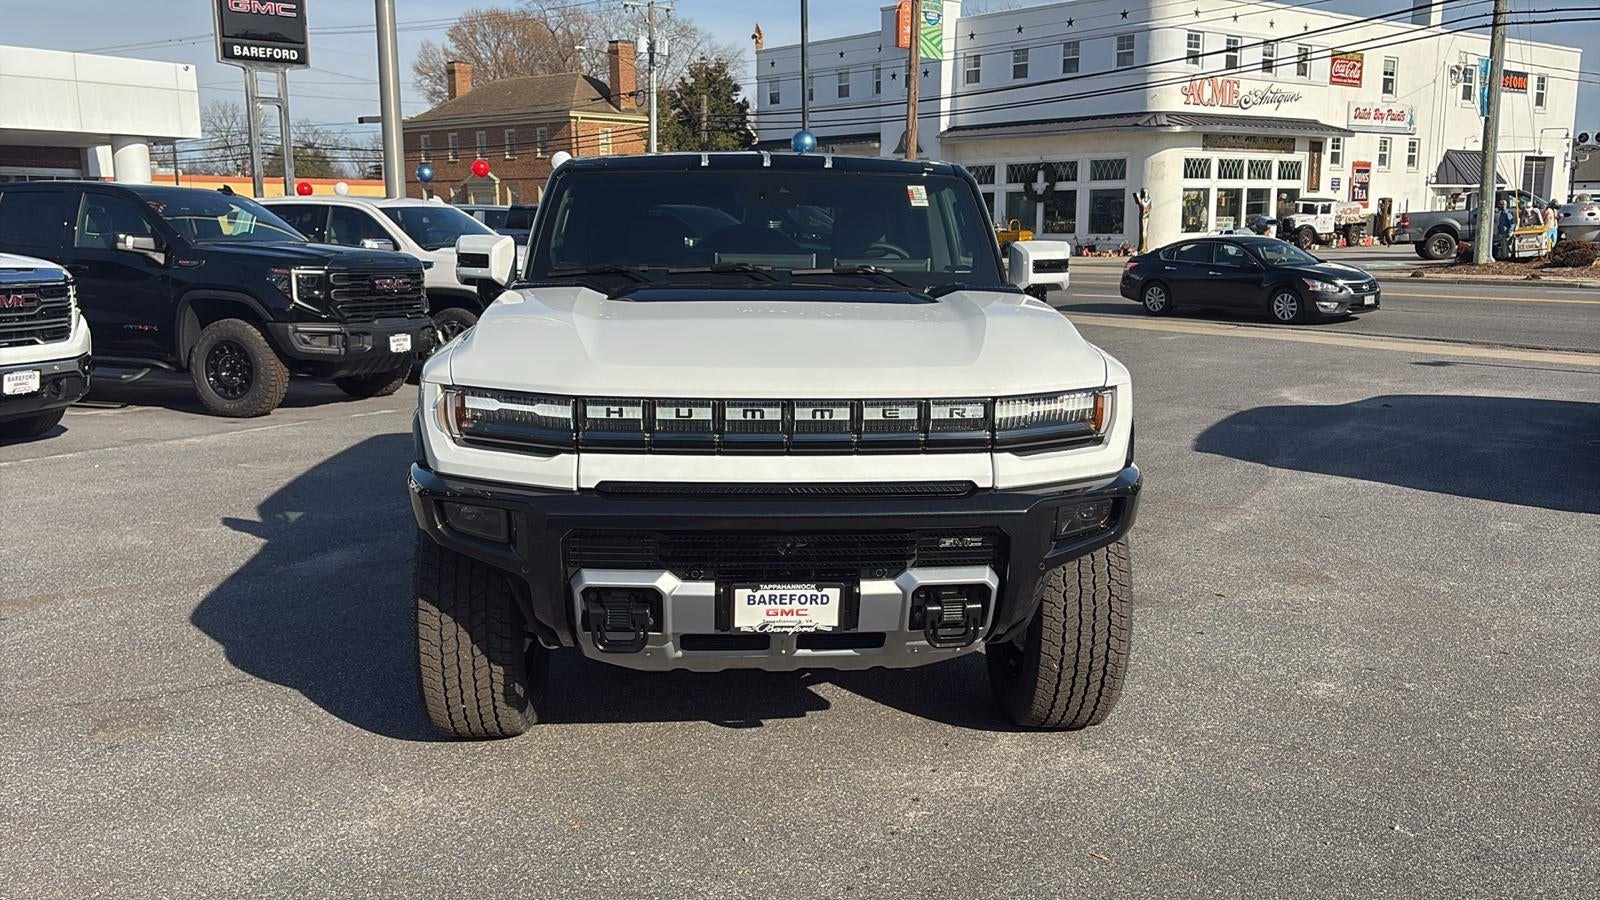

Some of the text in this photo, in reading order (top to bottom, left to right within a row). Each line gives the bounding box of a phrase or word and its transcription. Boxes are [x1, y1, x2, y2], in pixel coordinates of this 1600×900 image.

[229, 0, 297, 17] GMC
[233, 45, 298, 60] BAREFORD
[1181, 76, 1302, 111] ACME Antiques
[1353, 107, 1406, 123] Dutch Boy Paints
[1354, 187, 1366, 199] TEA
[0, 294, 37, 308] MC
[939, 537, 982, 547] GMC
[747, 594, 830, 605] BAREFORD
[766, 608, 808, 616] GMC
[756, 622, 819, 635] Bareford
